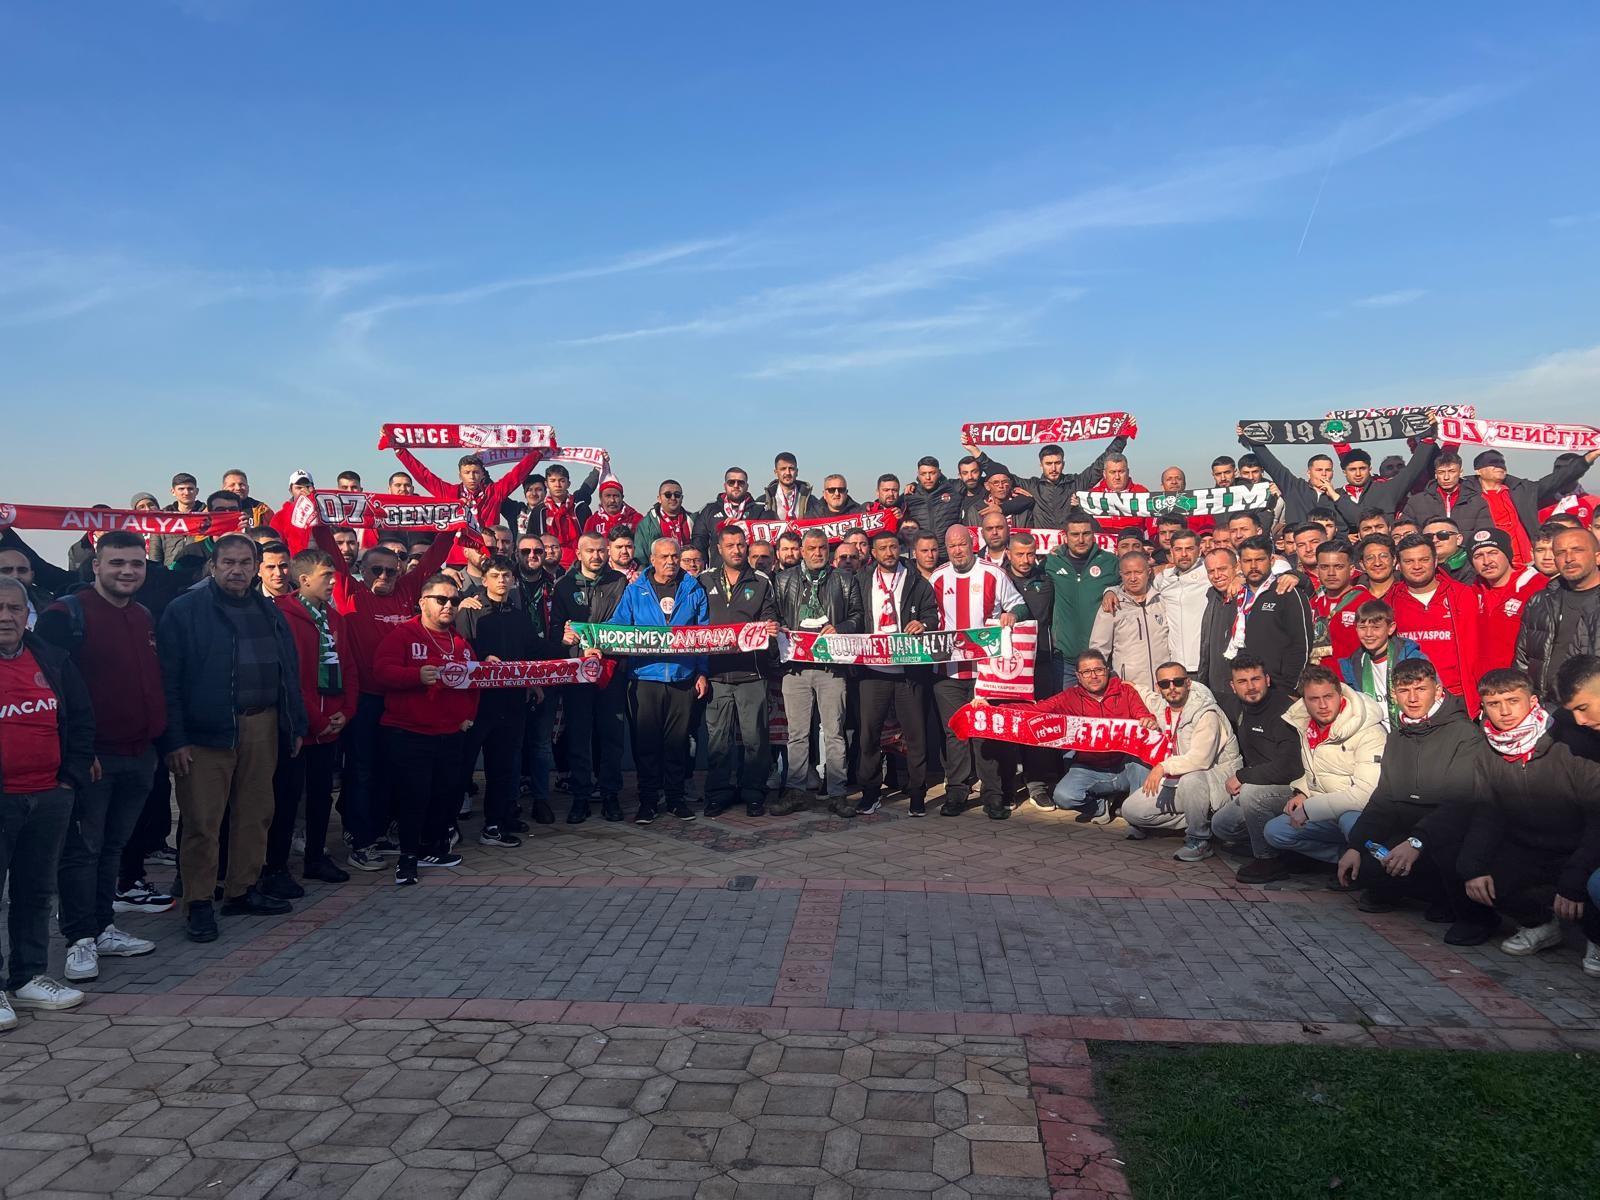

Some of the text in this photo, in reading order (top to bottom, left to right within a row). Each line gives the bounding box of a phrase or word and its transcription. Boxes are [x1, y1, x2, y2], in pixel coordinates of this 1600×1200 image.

[394, 427, 449, 444] SINCE
[1284, 418, 1393, 443] 19 66
[315, 493, 367, 524] 07
[1076, 490, 1149, 517] UNI
[1193, 482, 1270, 515] HM
[61, 510, 189, 533] ANTALYA
[752, 522, 787, 546] 07
[469, 663, 580, 680] ANTALYASPOR
